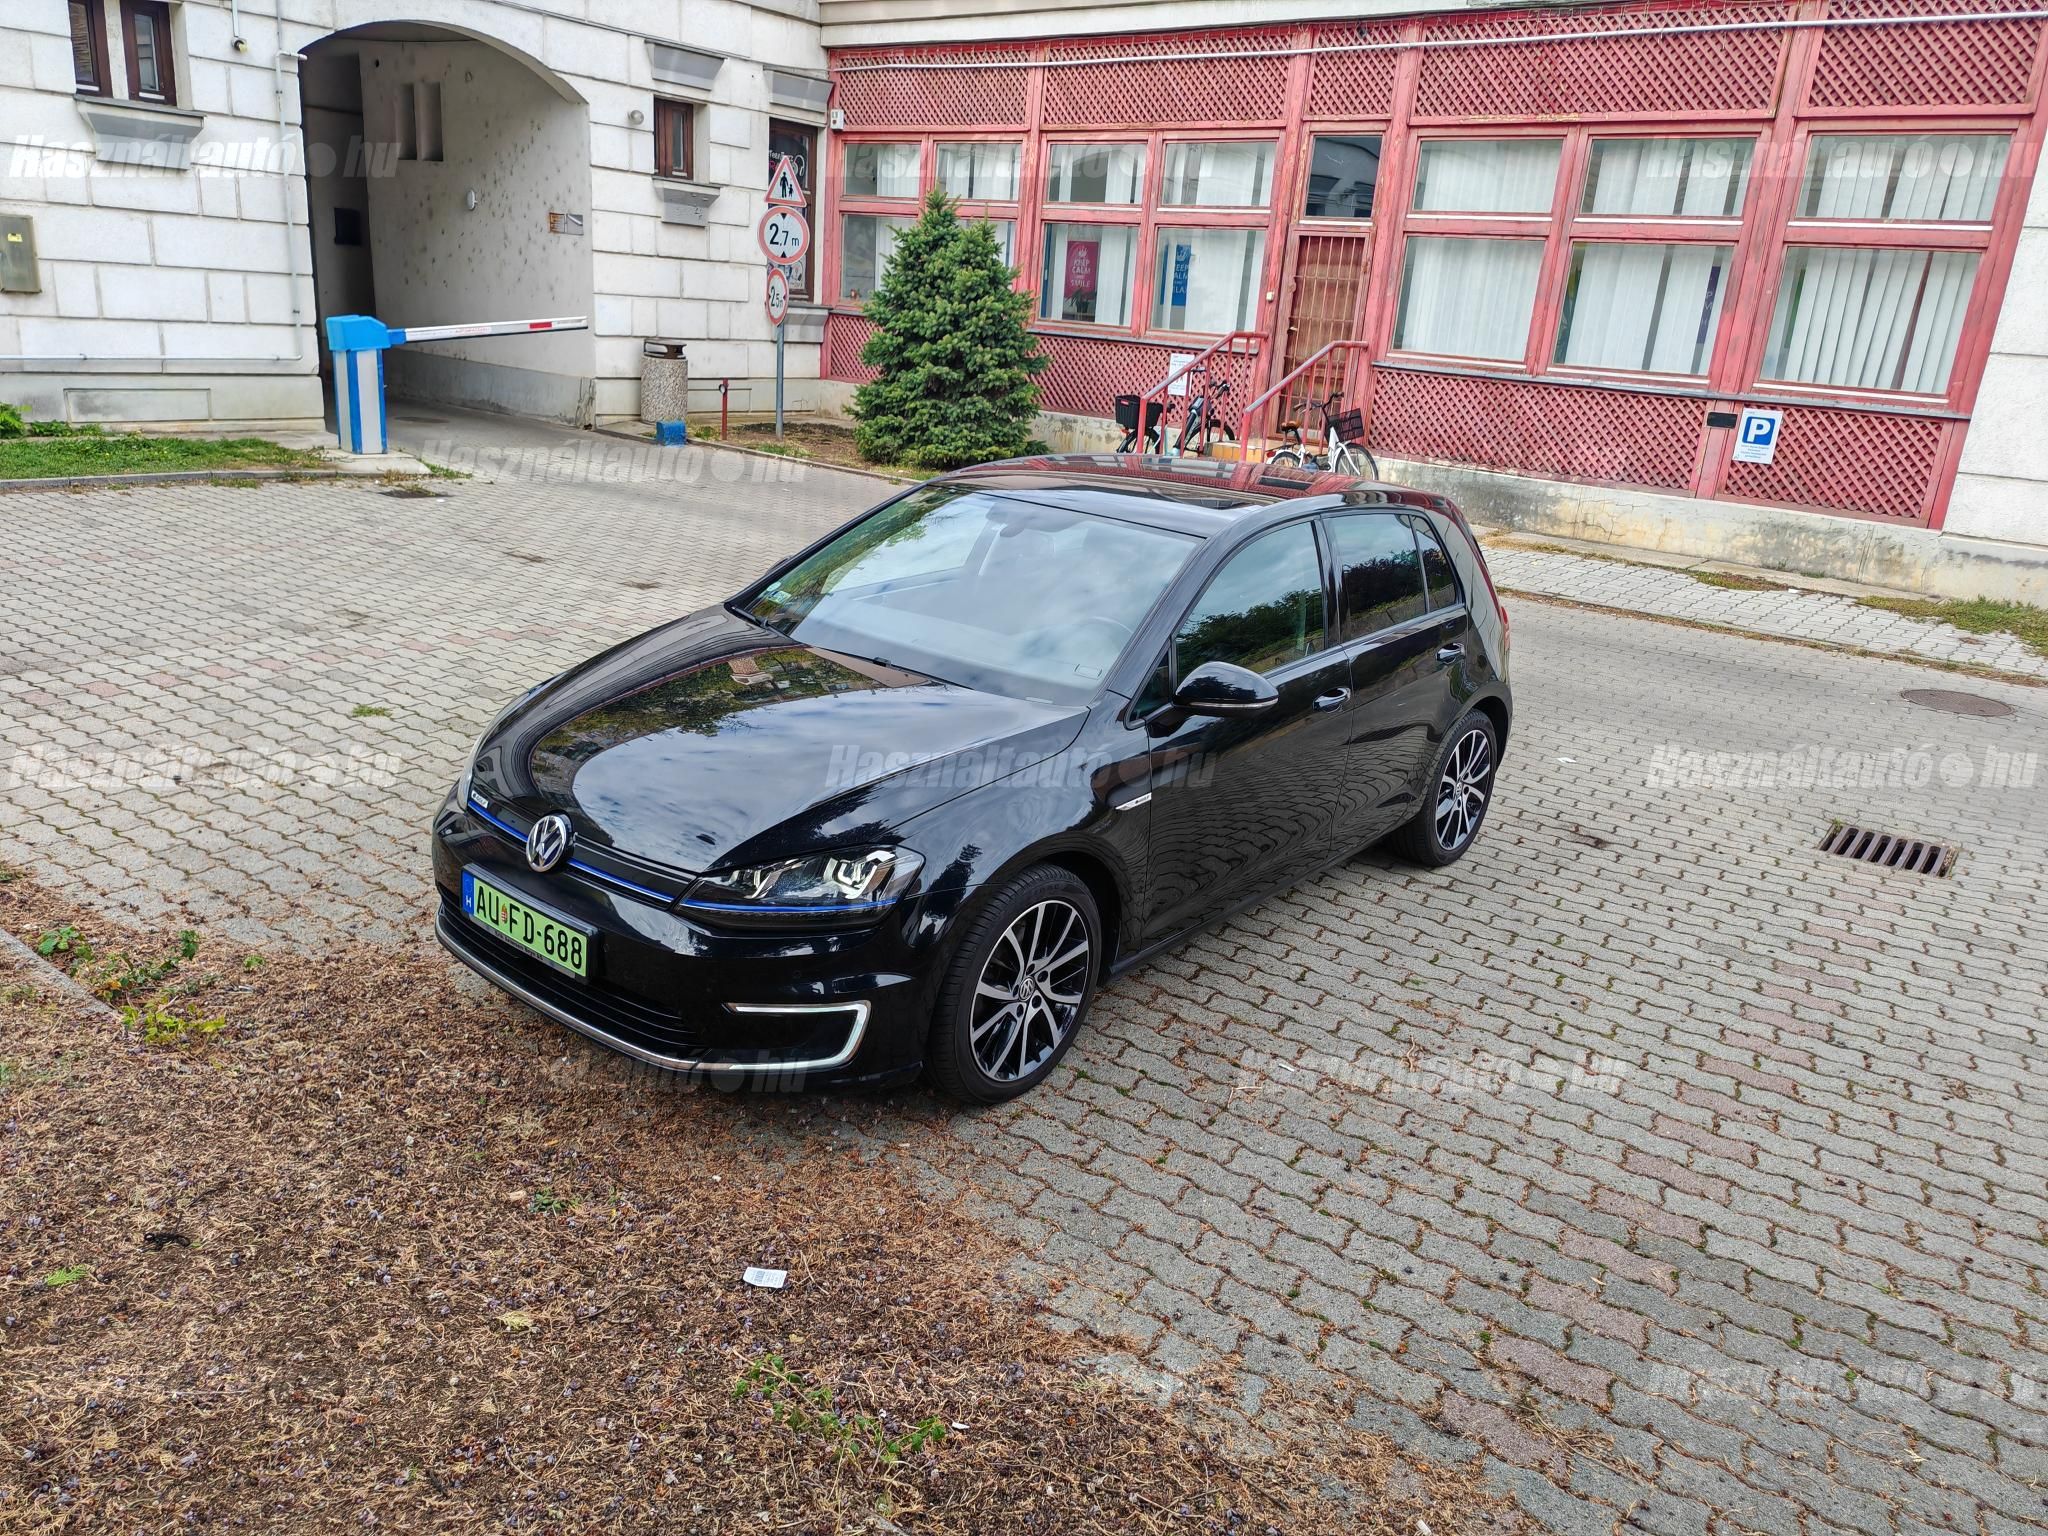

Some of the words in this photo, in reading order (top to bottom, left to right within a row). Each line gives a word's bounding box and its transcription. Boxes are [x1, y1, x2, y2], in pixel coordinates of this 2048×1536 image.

[1175, 264, 1189, 272] EEP
[1173, 272, 1188, 280] ALM
[1746, 418, 1771, 443] P
[465, 895, 473, 908] H
